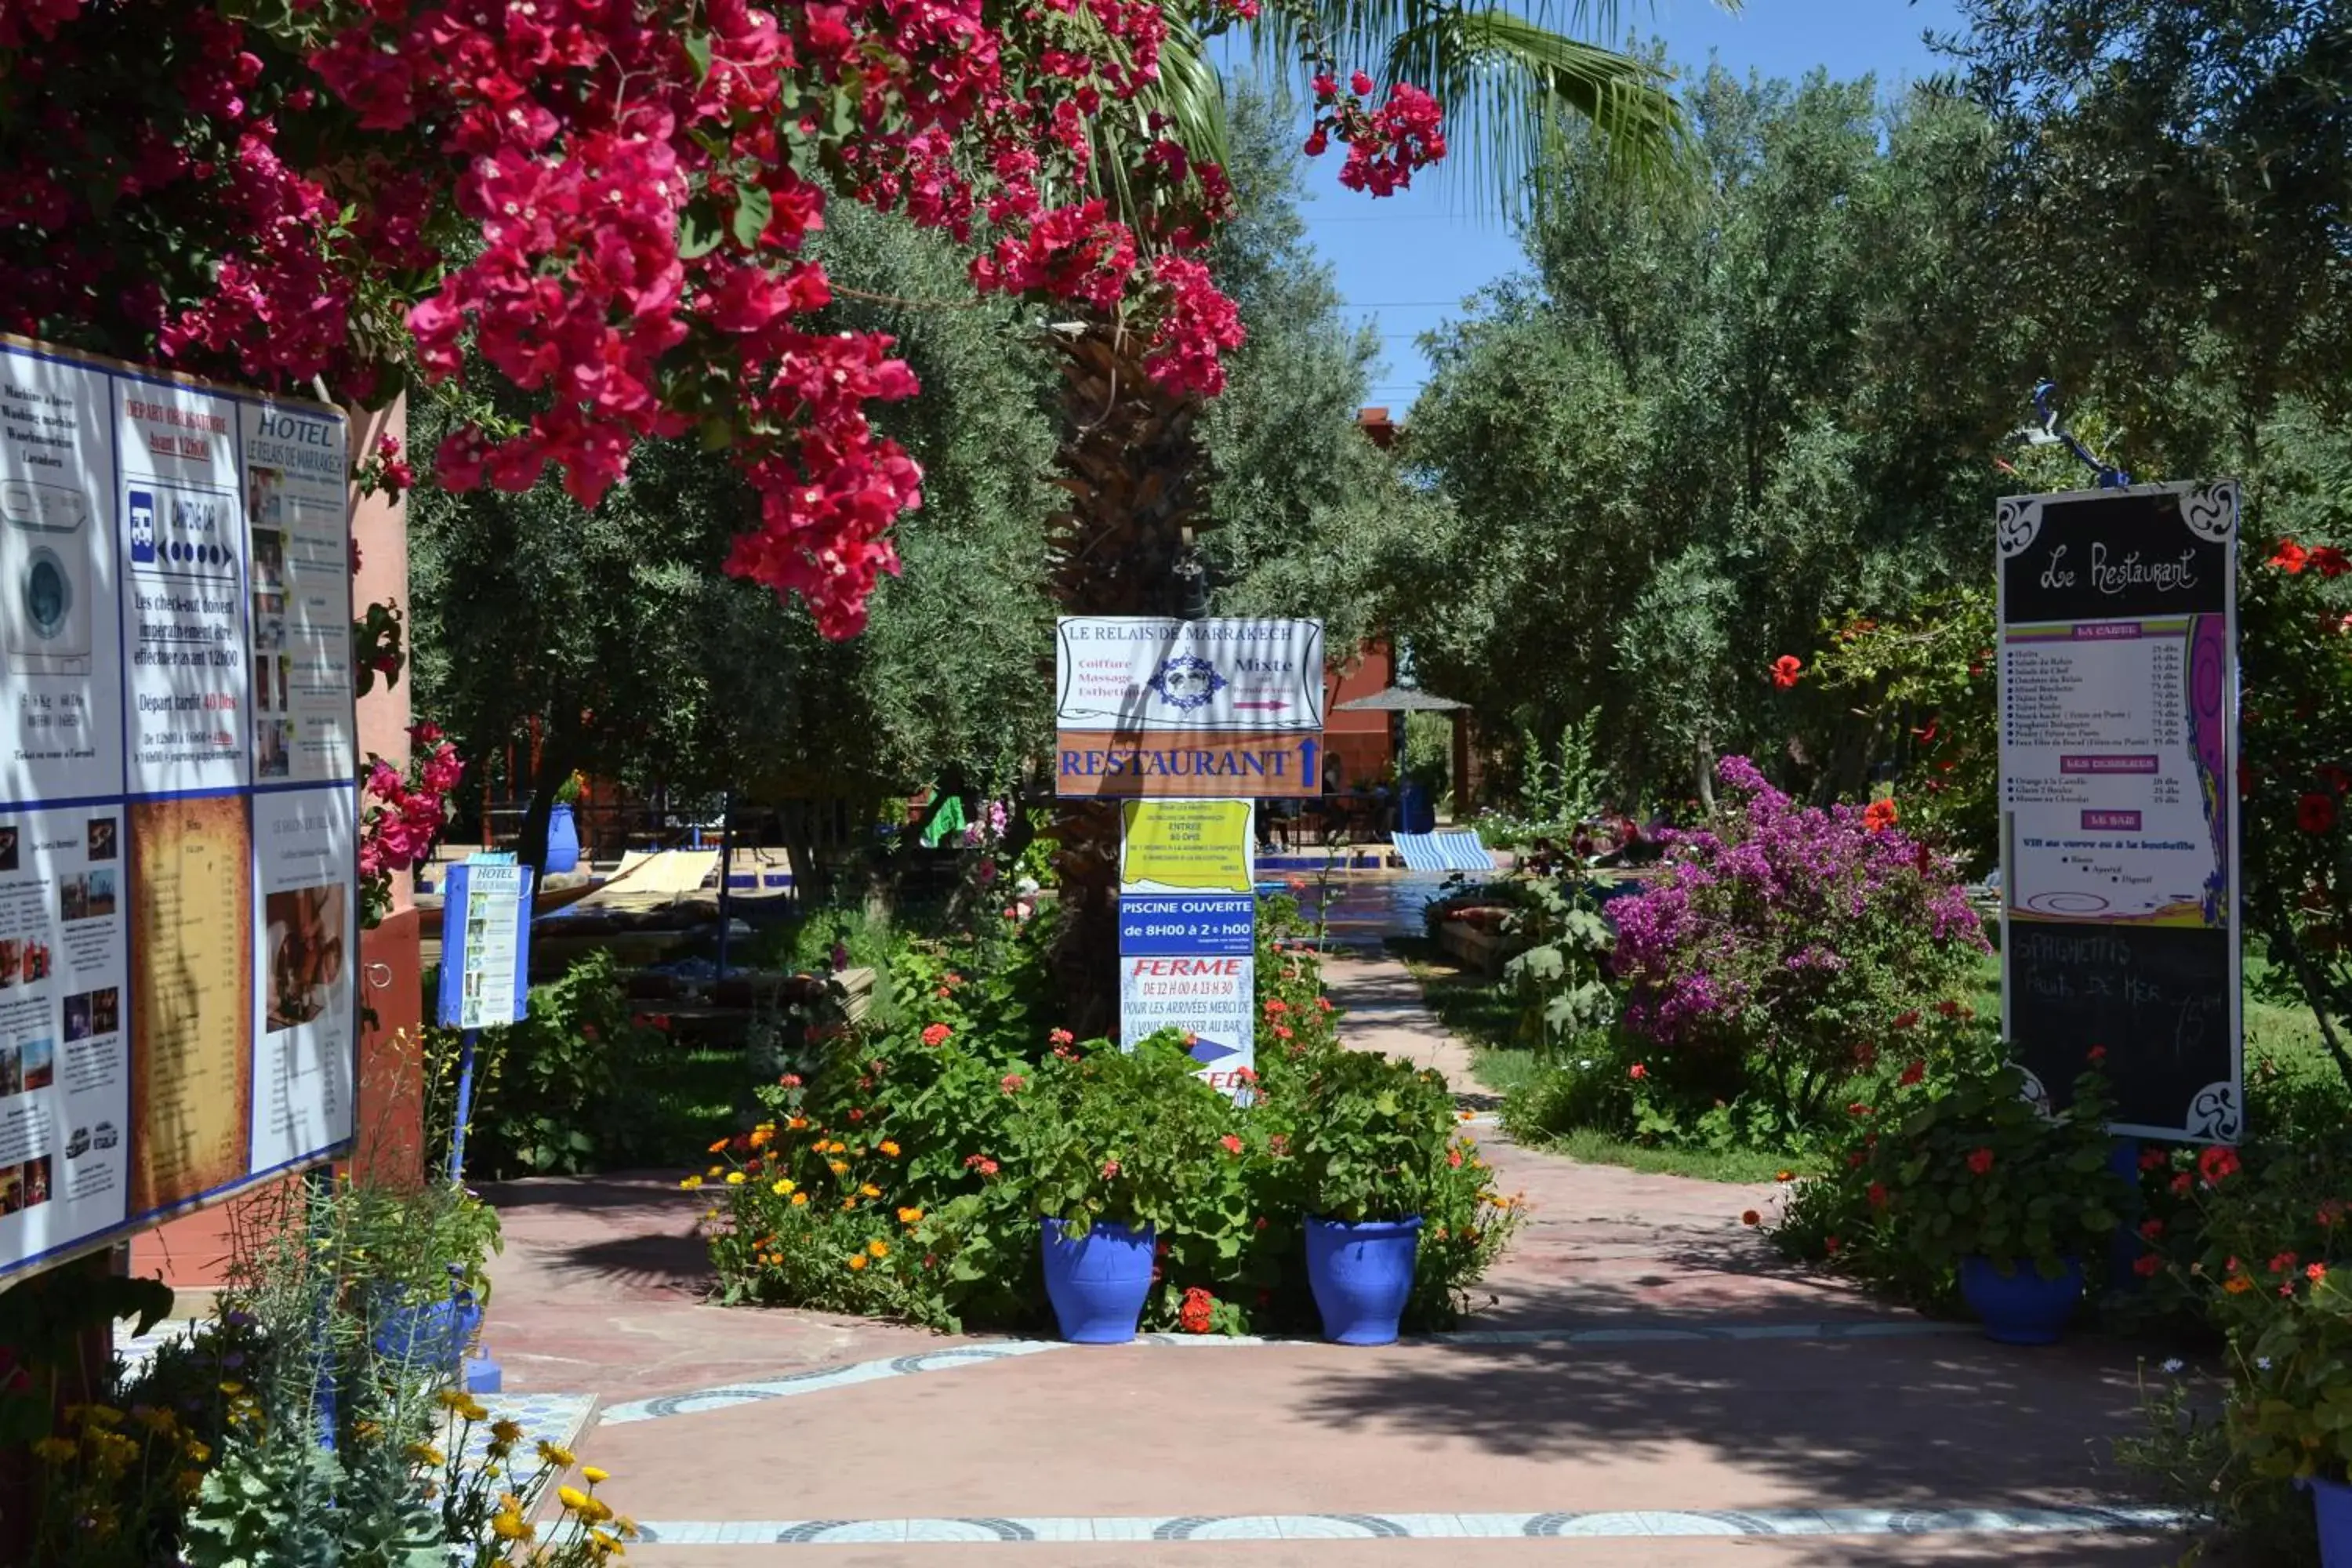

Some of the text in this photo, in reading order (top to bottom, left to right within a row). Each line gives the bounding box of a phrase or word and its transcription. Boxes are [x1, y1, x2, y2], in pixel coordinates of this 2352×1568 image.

[258, 412, 332, 447] HOTEL
[247, 439, 256, 459] LE
[257, 441, 284, 465] RELAIS
[285, 445, 296, 468] DE
[2040, 542, 2198, 594] Le Restaurant
[135, 592, 234, 615] Les check-out doivent
[1069, 627, 1294, 641] LE RELAIS DE MARRAKECH
[2078, 626, 2137, 637] LA CARTE
[180, 652, 205, 666] avant
[208, 650, 238, 667] 12h00
[1077, 659, 1133, 670] Coiffure
[1234, 658, 1293, 672] Mixte
[1077, 673, 1134, 684] Massage
[139, 693, 172, 713] Départ
[204, 692, 217, 710] 40
[1060, 750, 1292, 777] RESTAURANT
[477, 868, 515, 879] HOTEL
[1122, 901, 1252, 913] PISCINE OUVERTE
[1123, 924, 1143, 937] de
[1145, 924, 1185, 937] 8H00
[1188, 924, 1197, 935] à
[1133, 958, 1243, 977] FERME
[1143, 982, 1155, 996] DE
[1157, 982, 1167, 995] 12
[1169, 982, 1176, 995] H
[1178, 982, 1190, 995] 00
[1191, 982, 1198, 995] A
[1212, 982, 1220, 995] H
[1221, 982, 1233, 995] 30
[1123, 1001, 1147, 1014] POUR
[1149, 1002, 1165, 1014] LES
[1208, 1002, 1236, 1014] MERCI
[1237, 1001, 1250, 1014] DE
[1138, 1020, 1162, 1033] VOUS
[1208, 1021, 1221, 1033] AU
[1221, 1020, 1241, 1033] BAR
